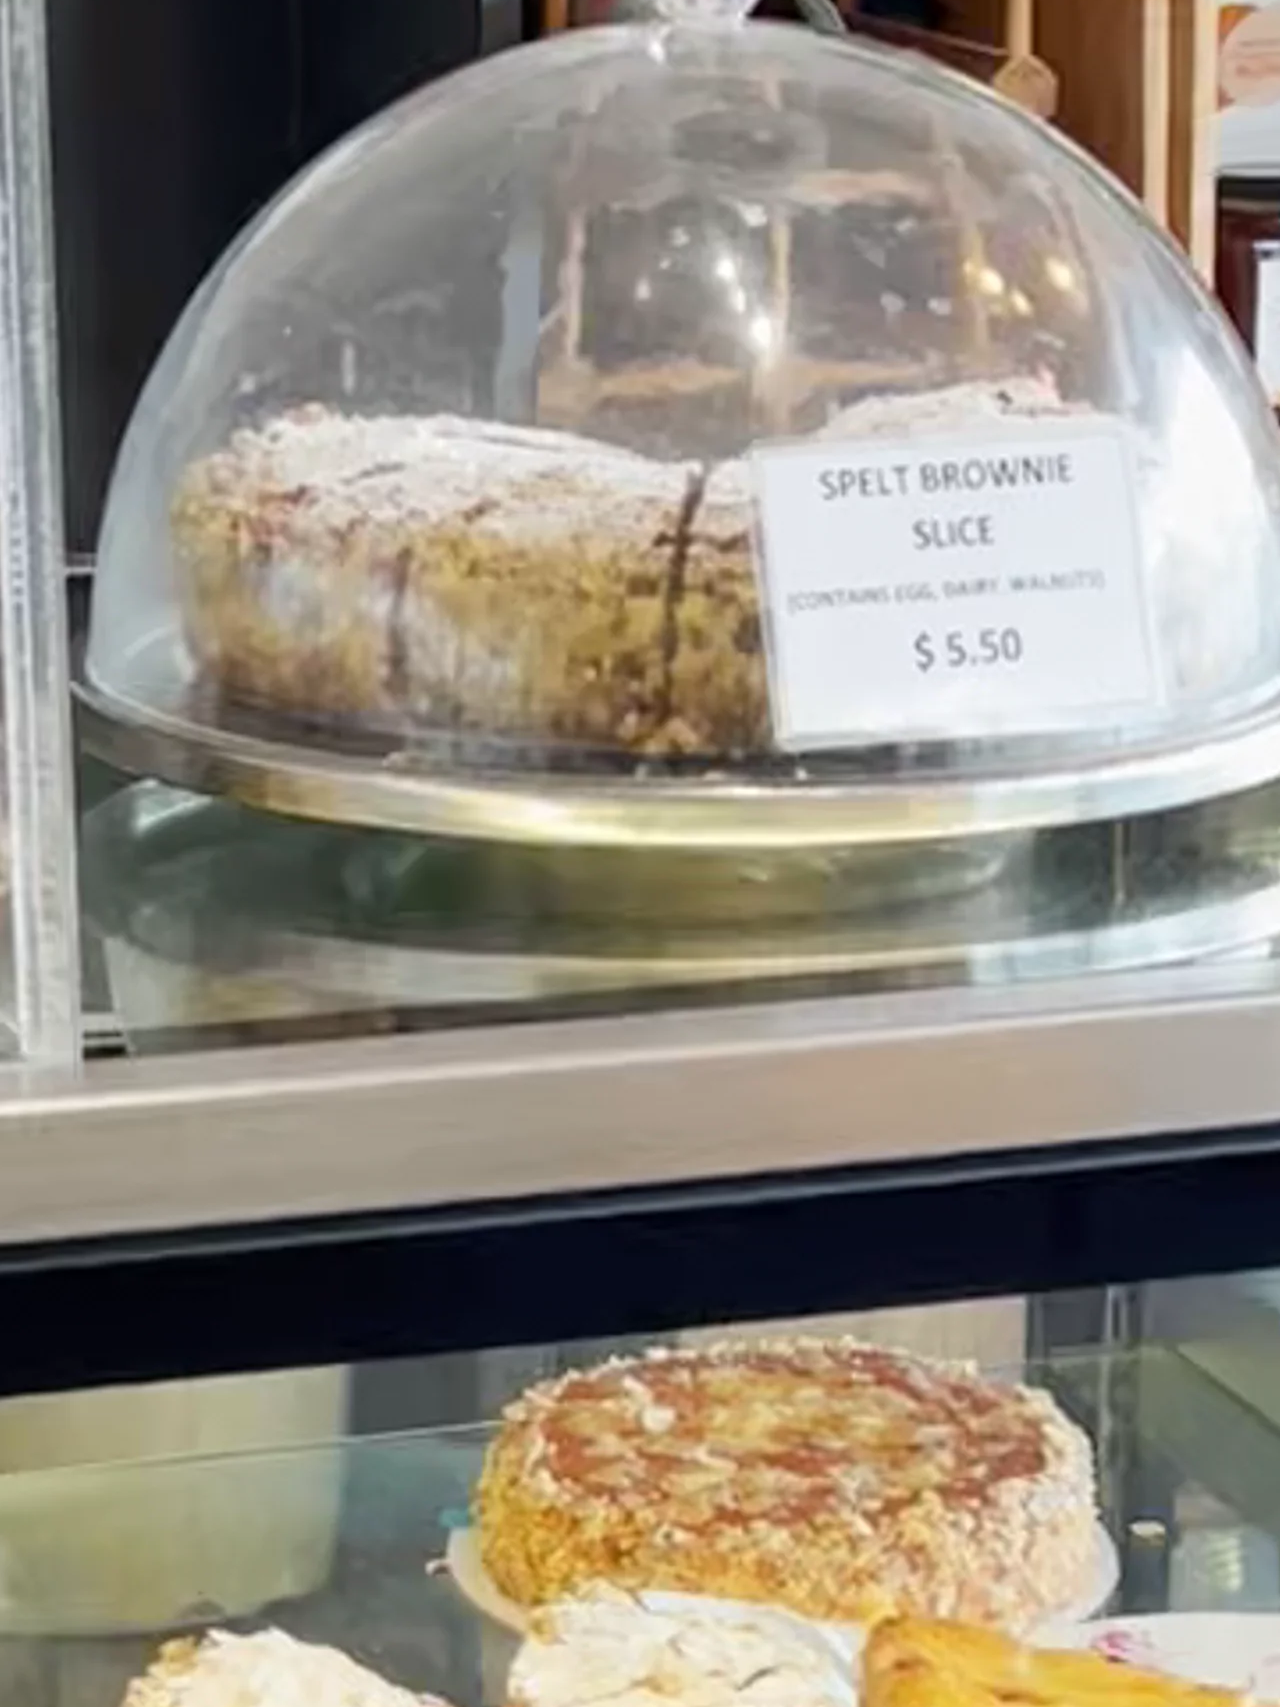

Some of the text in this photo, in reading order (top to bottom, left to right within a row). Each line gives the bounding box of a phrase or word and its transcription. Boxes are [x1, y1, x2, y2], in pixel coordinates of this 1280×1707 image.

[817, 453, 1074, 501] SPELT BROWNIE
[912, 516, 995, 551] SLICE
[914, 628, 1023, 673] $ 5.50
